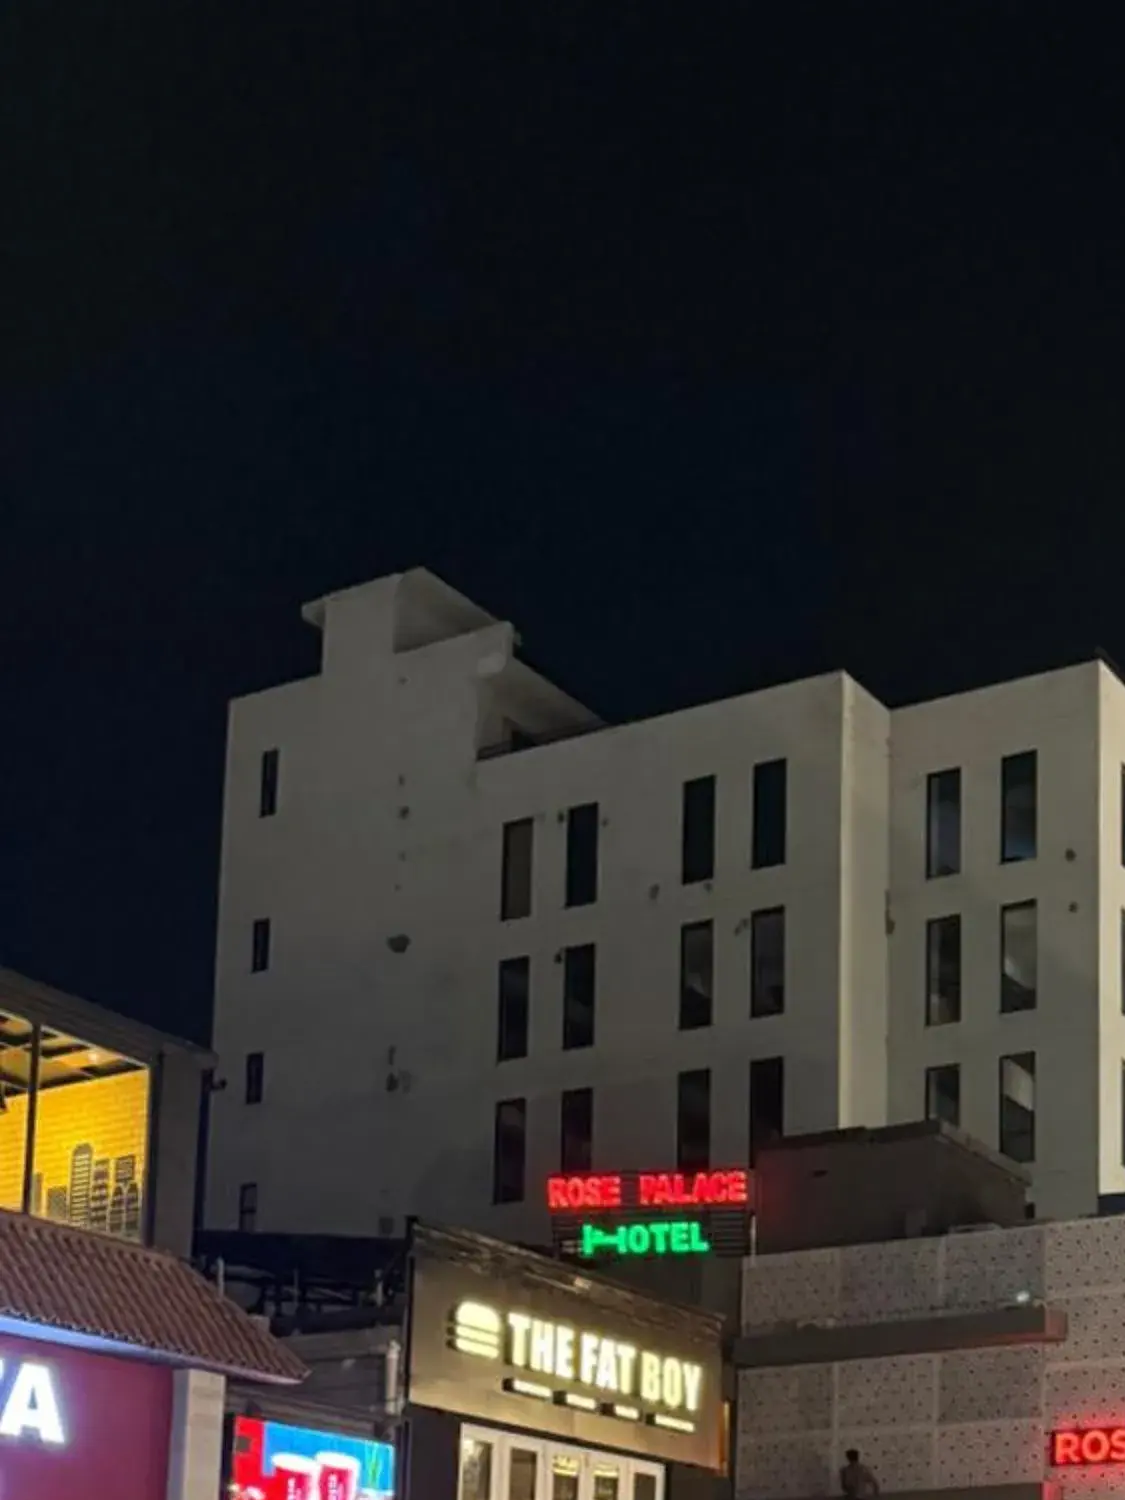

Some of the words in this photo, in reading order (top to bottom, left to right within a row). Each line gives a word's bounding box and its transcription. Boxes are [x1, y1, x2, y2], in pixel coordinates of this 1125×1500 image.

[547, 1175, 622, 1208] ROSE
[639, 1170, 748, 1205] PALACE
[581, 1221, 710, 1257] HOTEL
[507, 1312, 575, 1381] THE
[580, 1331, 636, 1396] FAT
[640, 1351, 702, 1412] BOY
[0, 1357, 65, 1443] A
